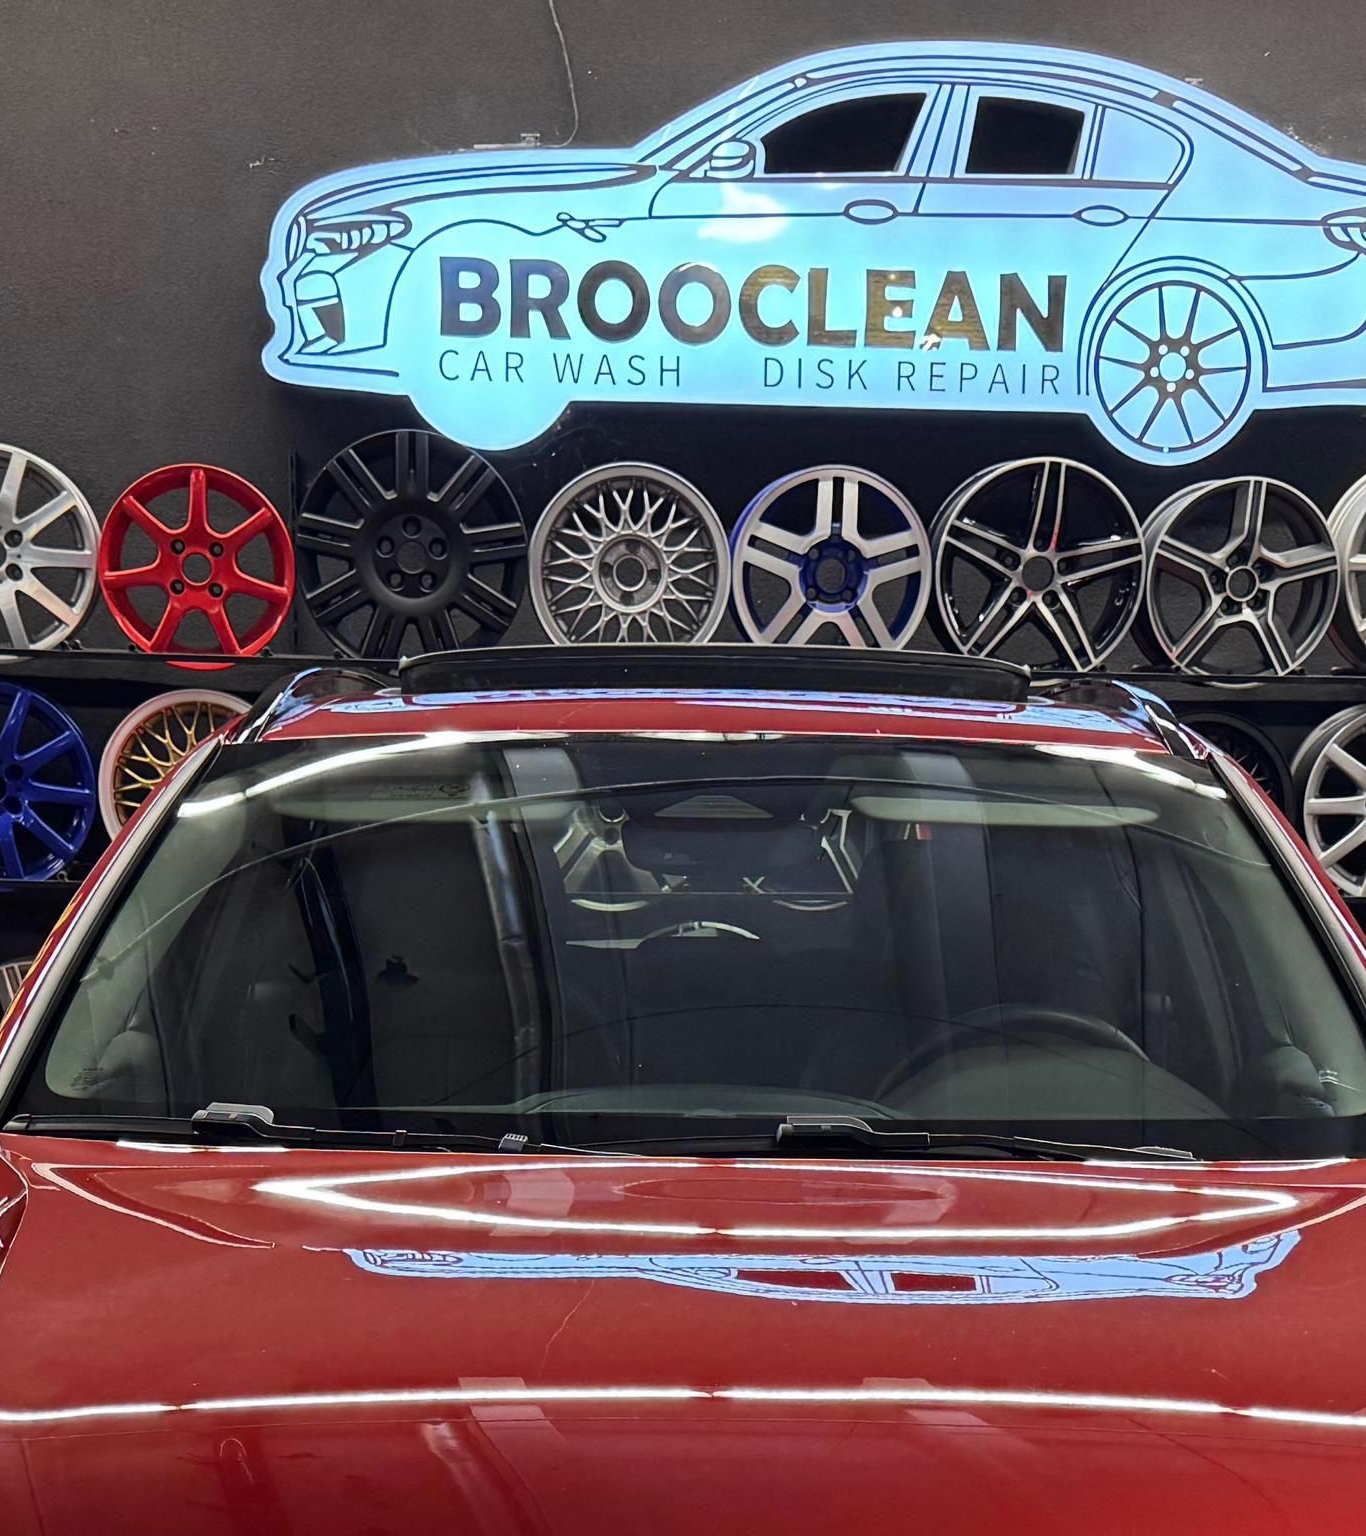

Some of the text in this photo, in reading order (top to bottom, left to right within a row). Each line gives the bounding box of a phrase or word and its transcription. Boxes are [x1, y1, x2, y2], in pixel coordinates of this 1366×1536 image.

[439, 255, 1067, 354] BROOCLEAN
[438, 348, 1061, 395] CAR WASH DISK REPAIR
